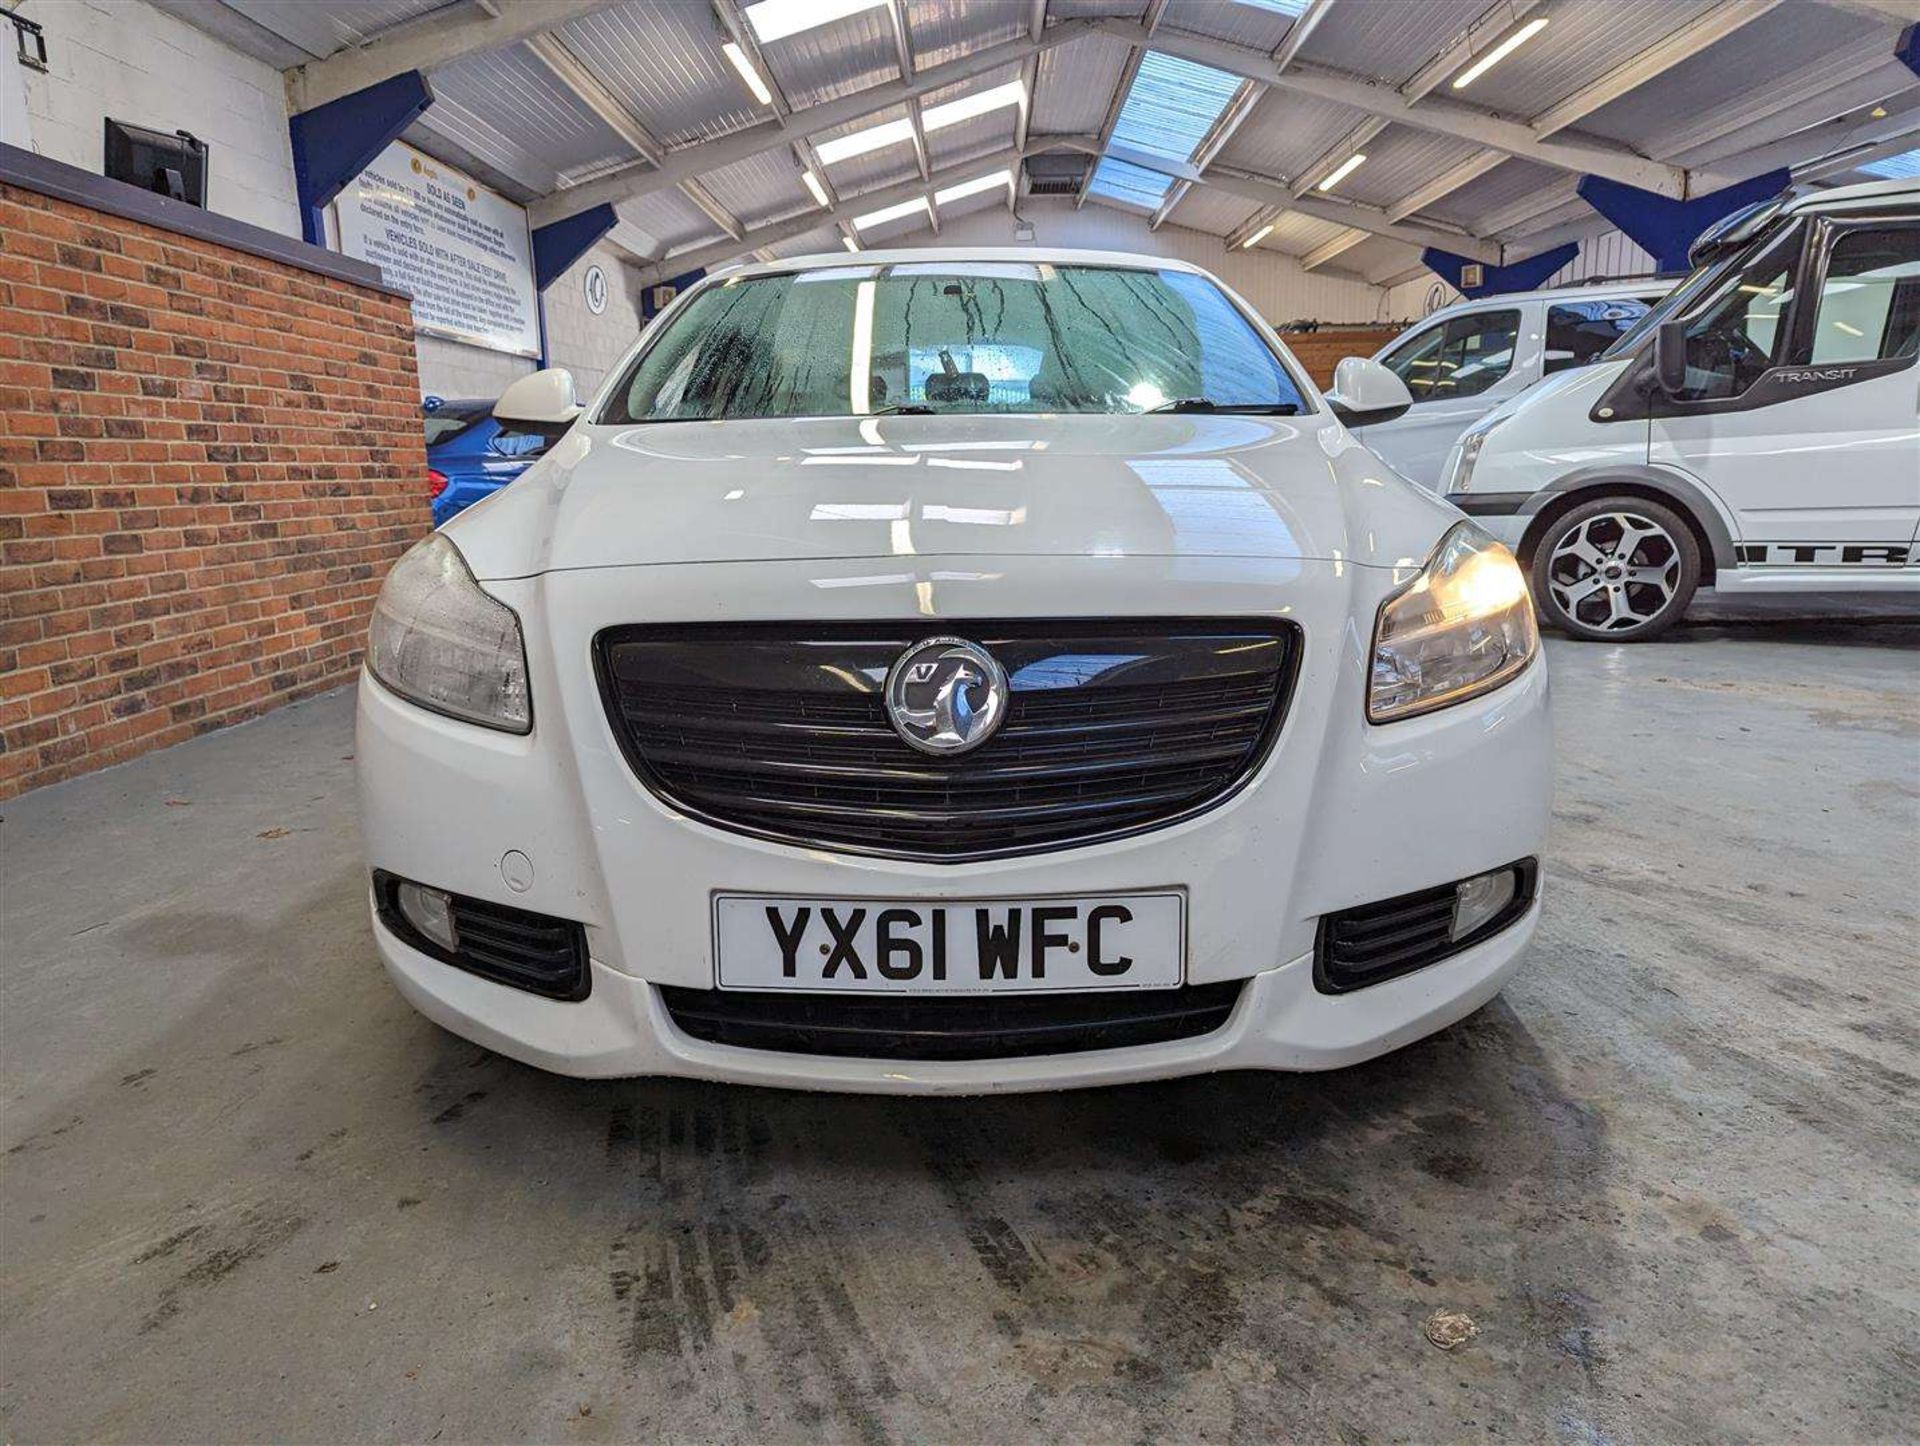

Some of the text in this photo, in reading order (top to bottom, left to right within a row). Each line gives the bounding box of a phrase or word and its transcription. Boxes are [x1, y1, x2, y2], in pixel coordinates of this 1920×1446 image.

[426, 182, 442, 199] SOLD
[451, 194, 465, 211] SEEN
[385, 227, 417, 249] VEHICLES
[418, 240, 434, 255] SOLD
[434, 246, 448, 261] WITH
[449, 252, 466, 267] AFTER
[467, 259, 480, 272] SALE
[1776, 368, 1858, 383] TRANSIT
[765, 904, 1134, 981] YX61 WFC
